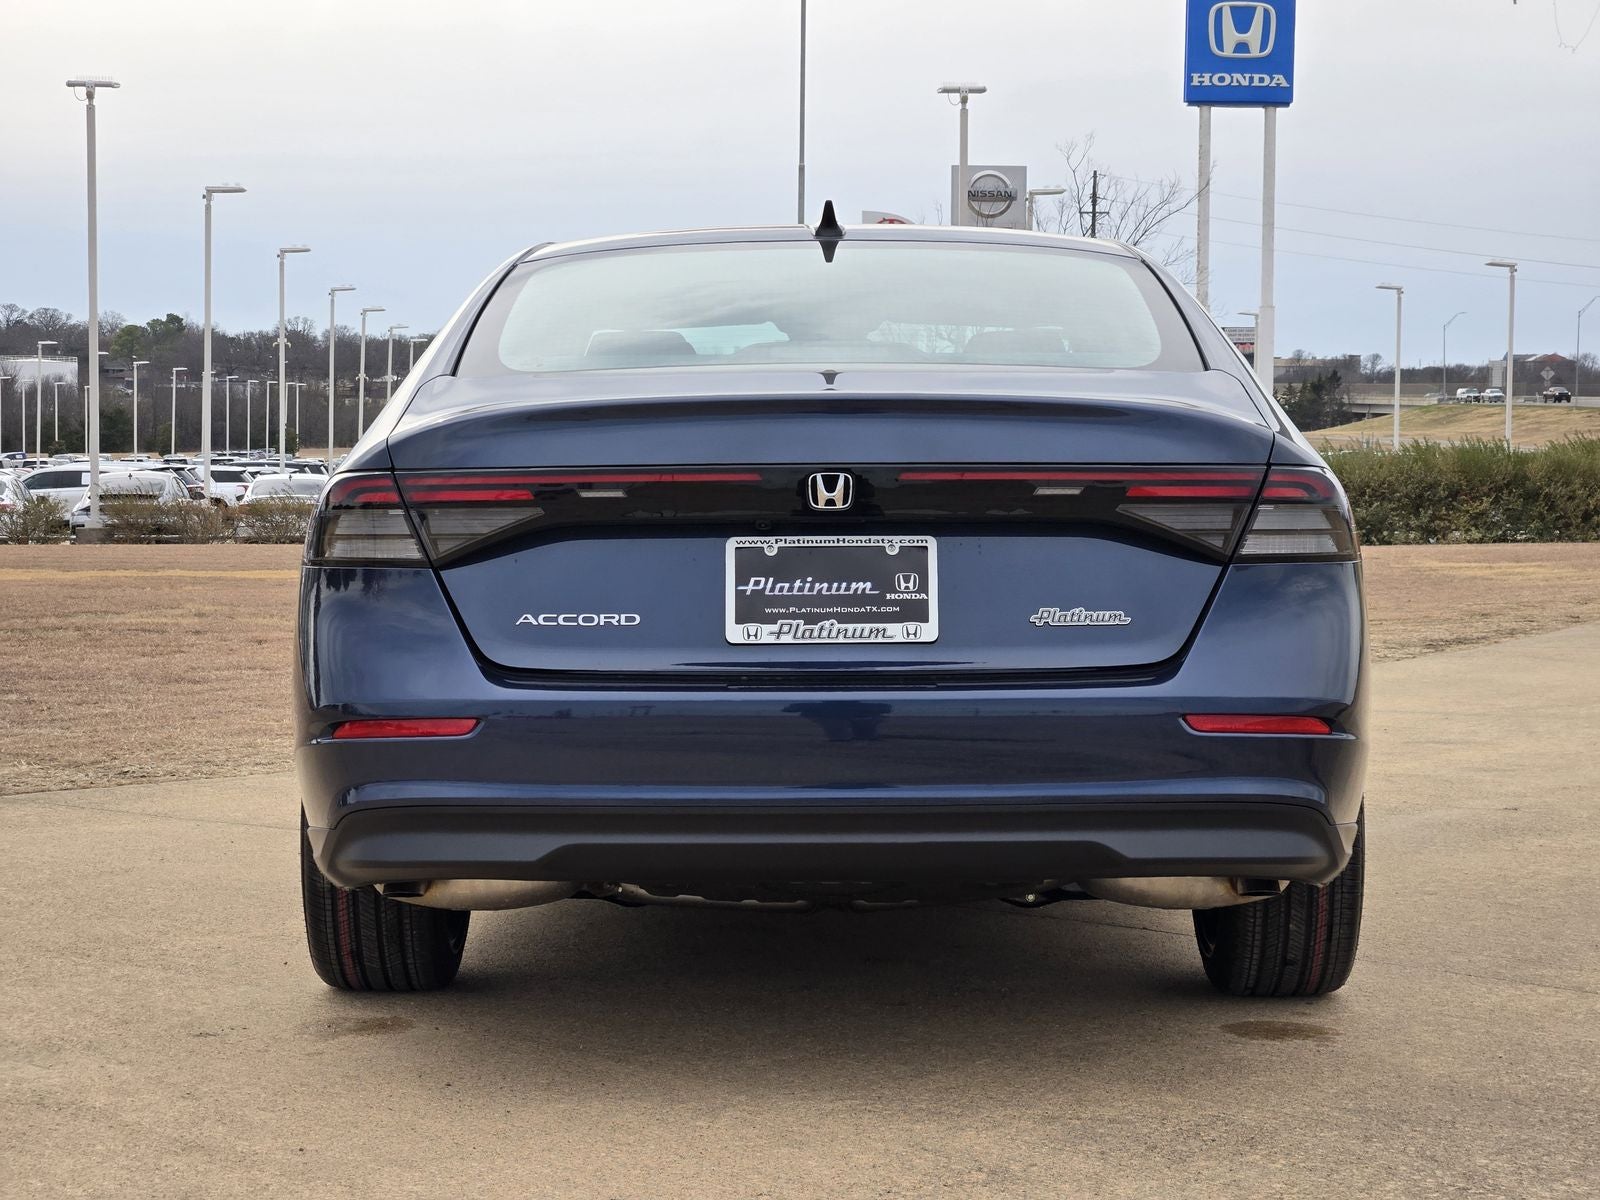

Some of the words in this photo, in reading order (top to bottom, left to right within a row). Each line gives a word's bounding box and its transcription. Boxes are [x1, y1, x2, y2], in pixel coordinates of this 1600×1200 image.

[1191, 73, 1290, 87] HONDA
[968, 190, 1012, 198] NISSAN
[735, 537, 928, 545] www.PlatinumHondatx.com
[737, 577, 880, 595] Platinum
[516, 613, 641, 626] ACCORD
[1030, 607, 1131, 626] Platinum
[767, 621, 896, 640] Platinum
